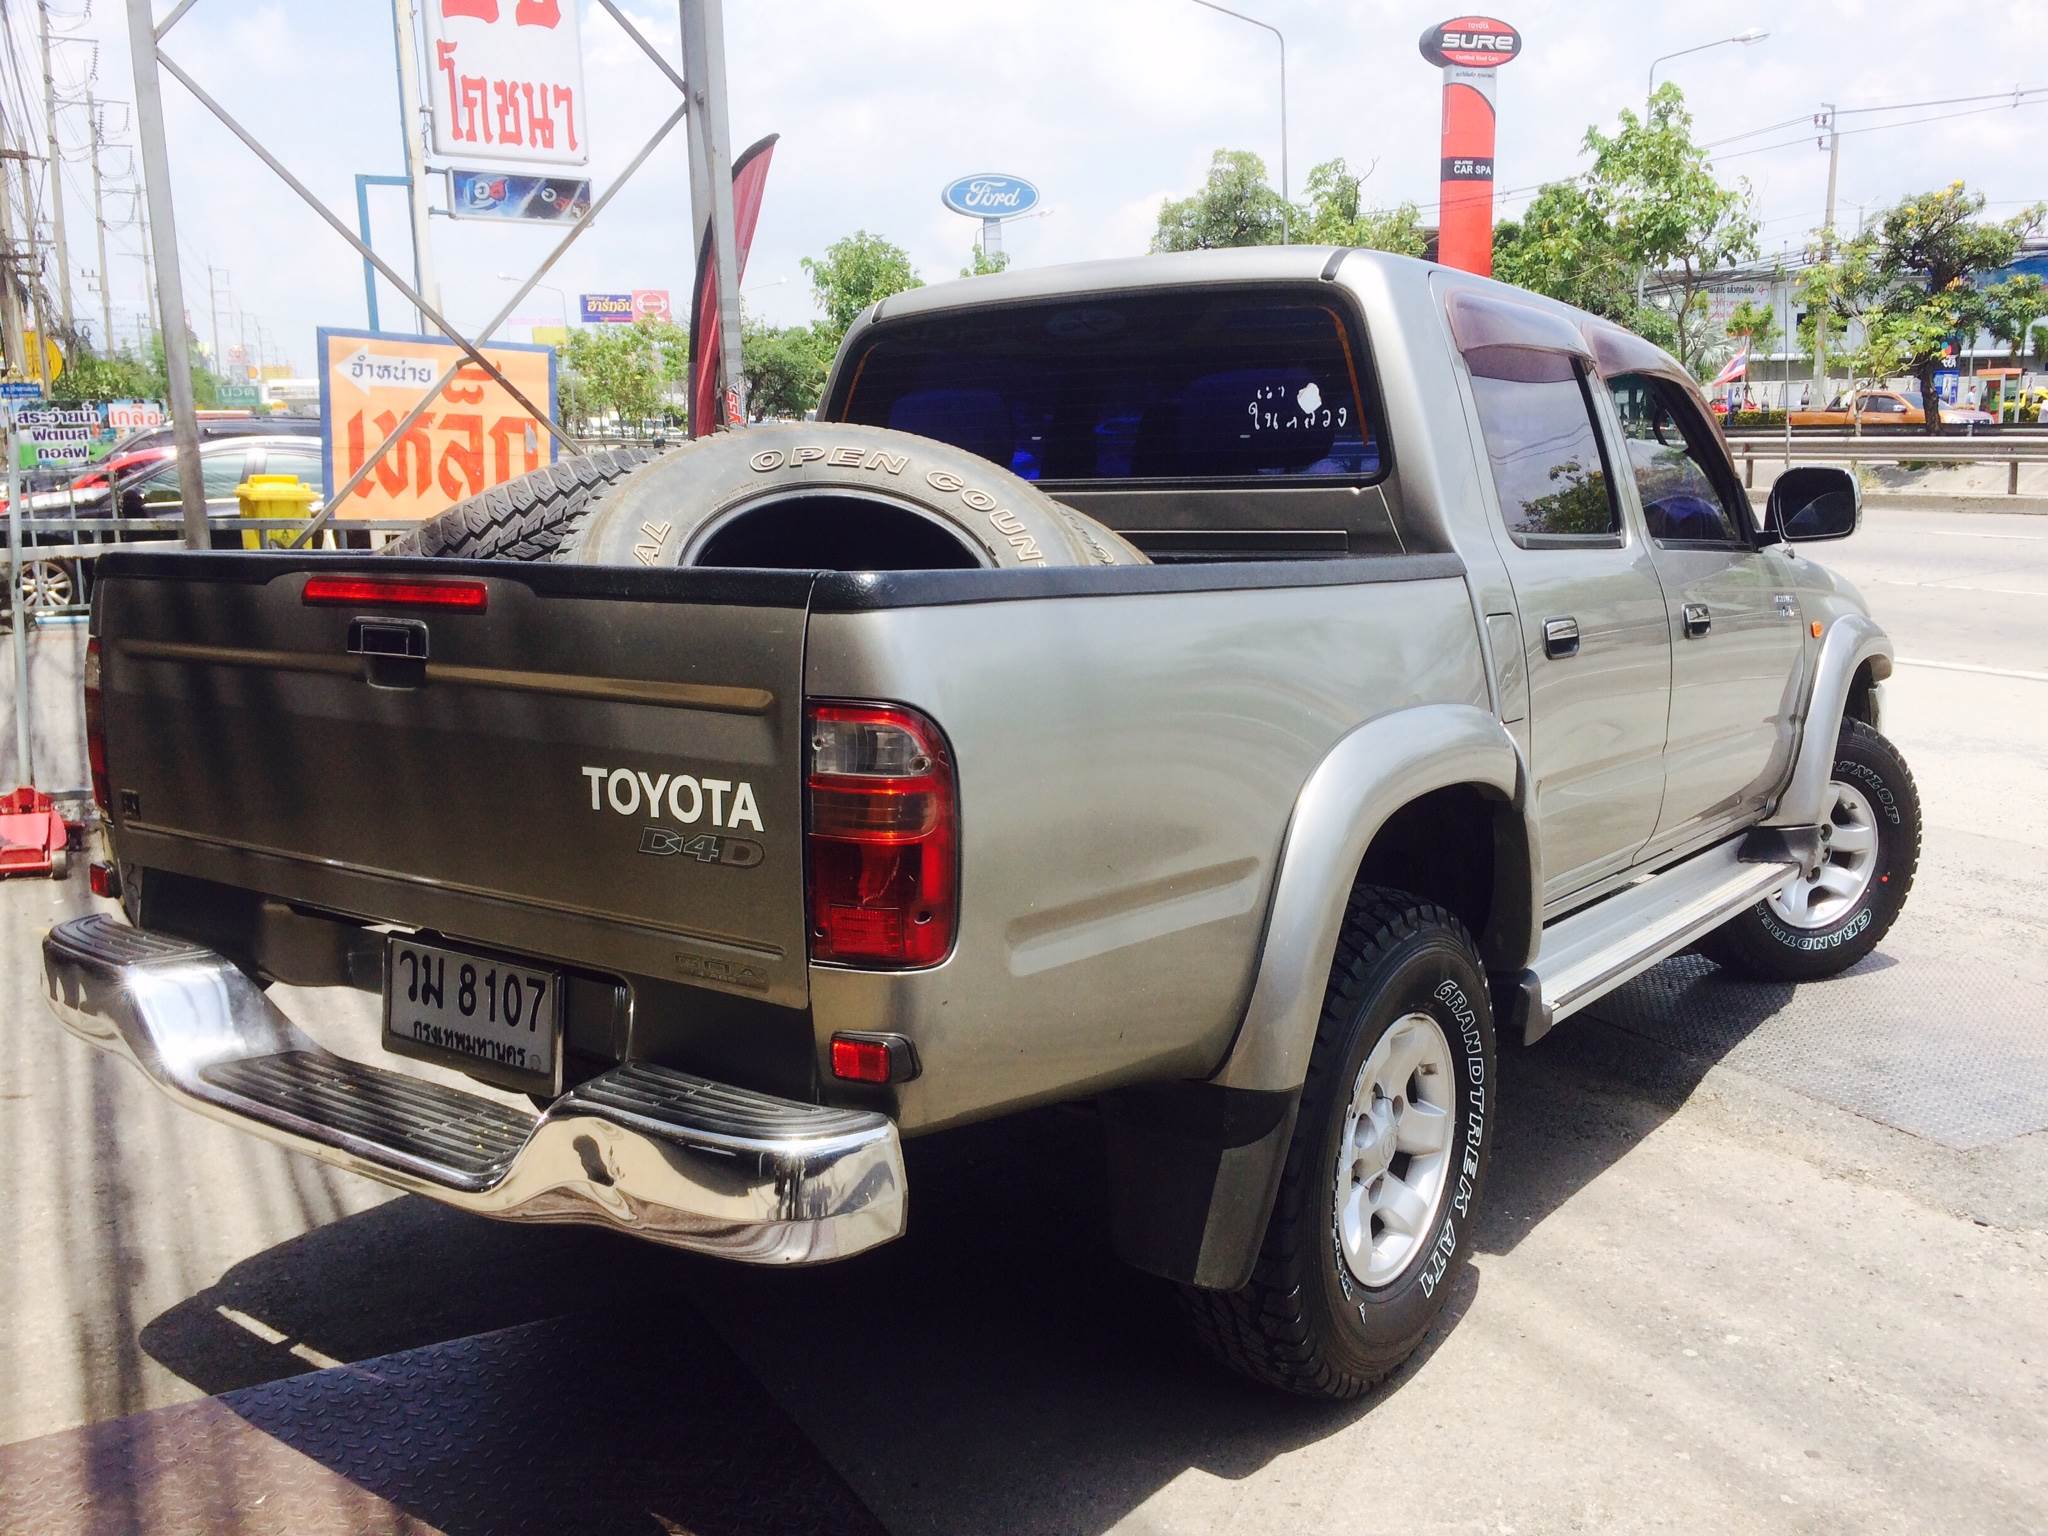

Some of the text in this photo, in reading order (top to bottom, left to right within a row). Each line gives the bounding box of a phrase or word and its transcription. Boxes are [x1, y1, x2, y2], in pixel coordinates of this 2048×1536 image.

[965, 180, 1020, 206] Ford
[1454, 165, 1492, 175] CAR SPA
[351, 355, 432, 383] จำหน่าย
[17, 403, 99, 424] สระว่ายน้ำ
[750, 446, 910, 475] OPEN
[926, 471, 1047, 568] COUN
[582, 766, 765, 832] TOYOTA
[1833, 760, 1900, 824] UNLOP
[399, 950, 546, 1032] วม 8107
[413, 1021, 526, 1066] กรุงเทพมหานคร
[1433, 980, 1485, 1219] GRANDTREK
